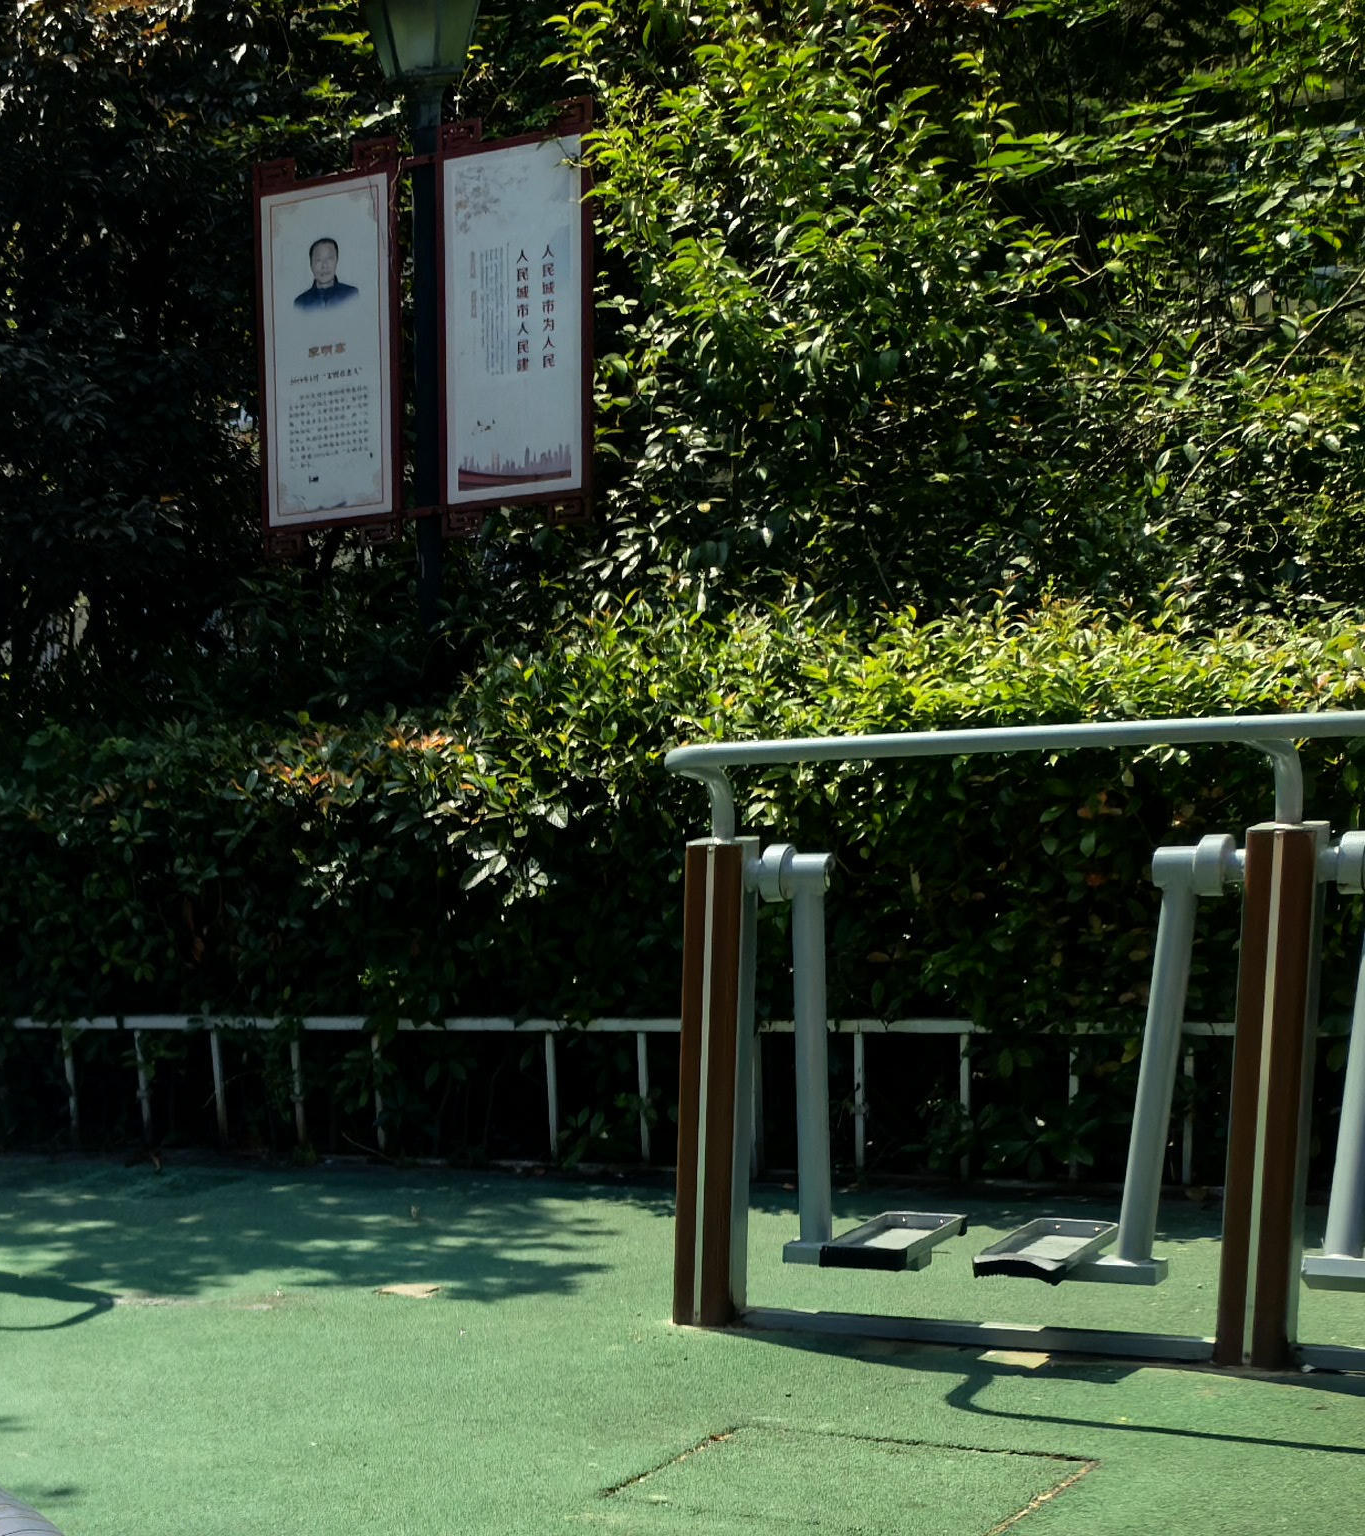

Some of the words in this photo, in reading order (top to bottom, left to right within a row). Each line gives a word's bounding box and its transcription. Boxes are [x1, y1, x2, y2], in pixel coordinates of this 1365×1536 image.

[515, 248, 529, 373] 人民城市人民建
[541, 243, 556, 369] 人民城市为人民
